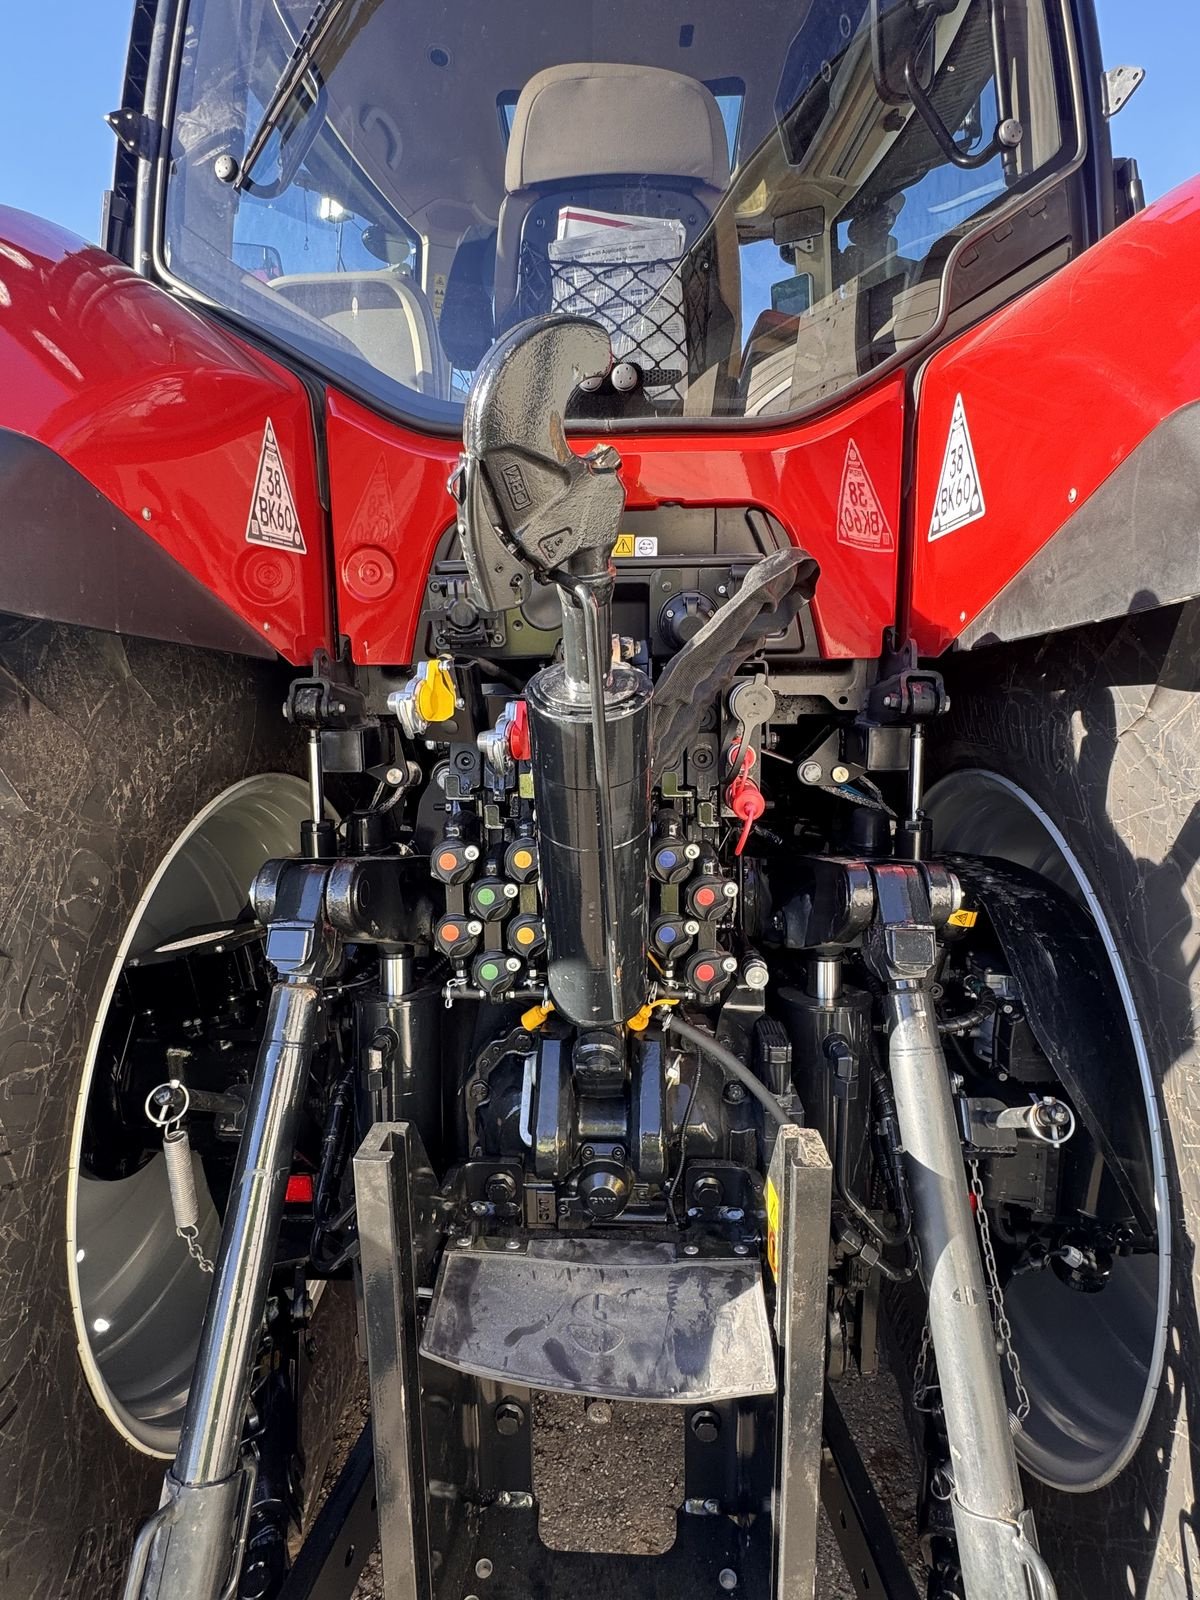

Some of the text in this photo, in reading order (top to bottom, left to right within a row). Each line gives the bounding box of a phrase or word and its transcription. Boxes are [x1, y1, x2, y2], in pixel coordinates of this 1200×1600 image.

[602, 246, 627, 255] Application
[950, 444, 963, 478] 38
[264, 465, 283, 500] 38
[941, 474, 971, 516] BK60
[258, 496, 293, 533] BK60
